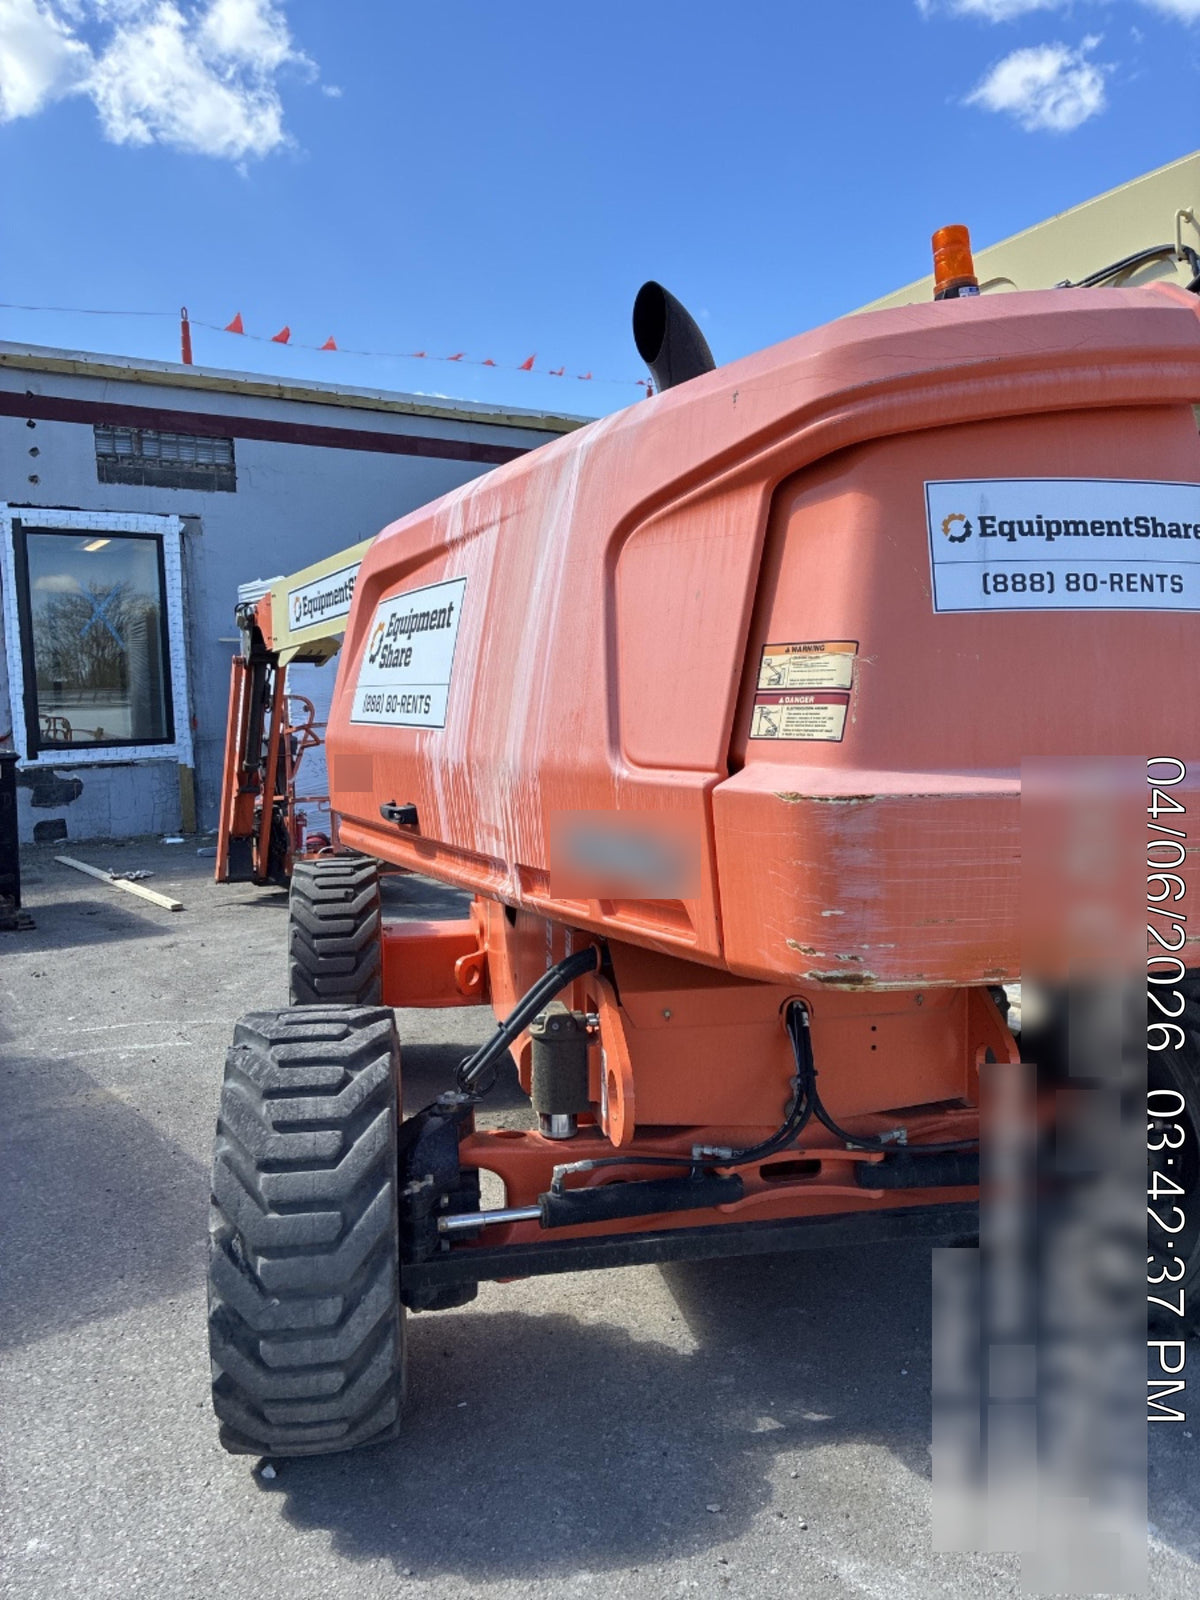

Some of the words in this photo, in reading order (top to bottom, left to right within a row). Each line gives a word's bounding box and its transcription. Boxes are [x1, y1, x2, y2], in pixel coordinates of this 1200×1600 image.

[982, 571, 1055, 595] (888)
[1065, 573, 1184, 593] 80-RENTS
[302, 576, 356, 619] EquipmentS
[385, 601, 454, 642] Equipment
[378, 643, 413, 669] Share
[791, 645, 825, 653] WARNING
[362, 693, 385, 713] (888)
[385, 694, 431, 714] 80-RENTS
[784, 696, 815, 704] DANGER
